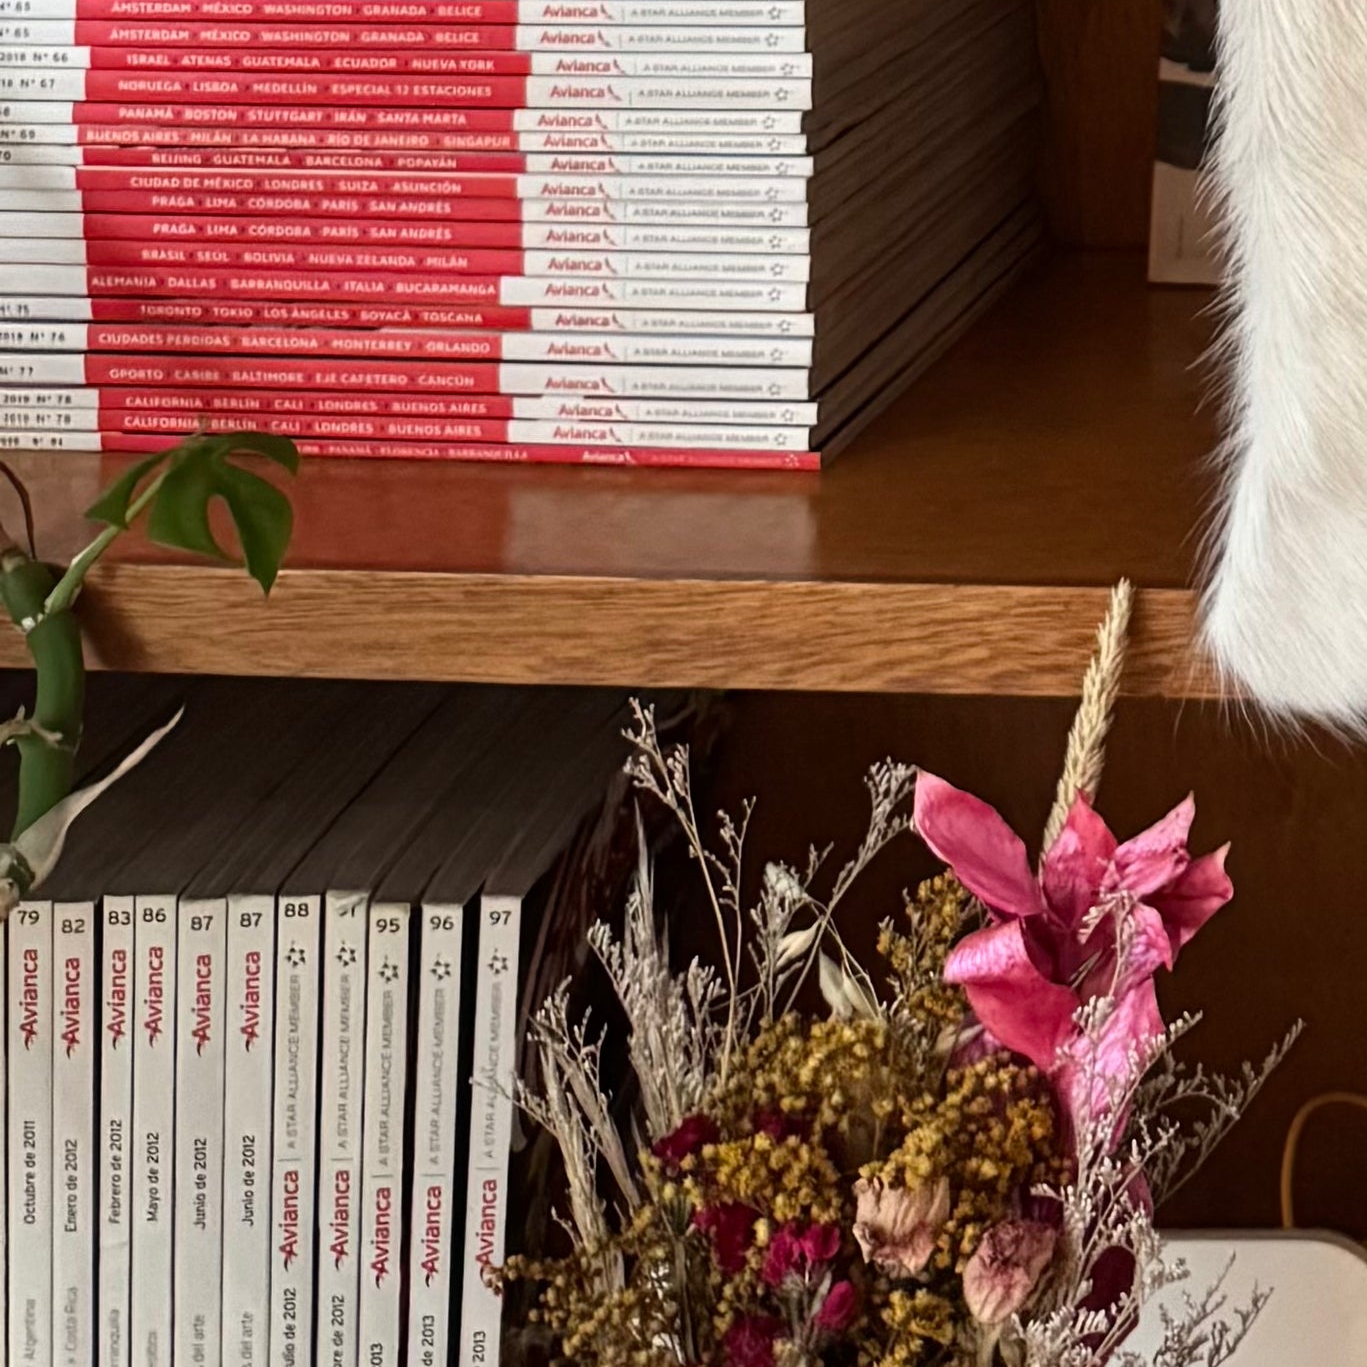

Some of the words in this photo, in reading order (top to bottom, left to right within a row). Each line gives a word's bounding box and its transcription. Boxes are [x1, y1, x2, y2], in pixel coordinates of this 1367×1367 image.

[118, 81, 182, 92] NORUEGA
[193, 81, 238, 93] LISBOA
[332, 83, 390, 95] ESPECIAL
[413, 85, 492, 97] ESTACIONES
[550, 85, 605, 99] Avianca
[17, 910, 40, 926] 79
[108, 910, 131, 927] 83
[142, 908, 167, 924] 86
[284, 902, 309, 919] 88
[489, 910, 512, 927] 97
[61, 918, 85, 934] 82
[239, 912, 262, 928] 87
[376, 918, 400, 933] 95
[429, 916, 454, 931] 96
[20, 948, 39, 1039] Avianca
[24, 1120, 36, 1144] 2011
[110, 1119, 123, 1155] 2012
[24, 1147, 36, 1167] de
[109, 1159, 121, 1179] de
[24, 1171, 36, 1225] Octubre
[108, 1183, 121, 1225] Febrero
[279, 1170, 299, 1259] Avianca
[422, 1185, 442, 1274] Avianca
